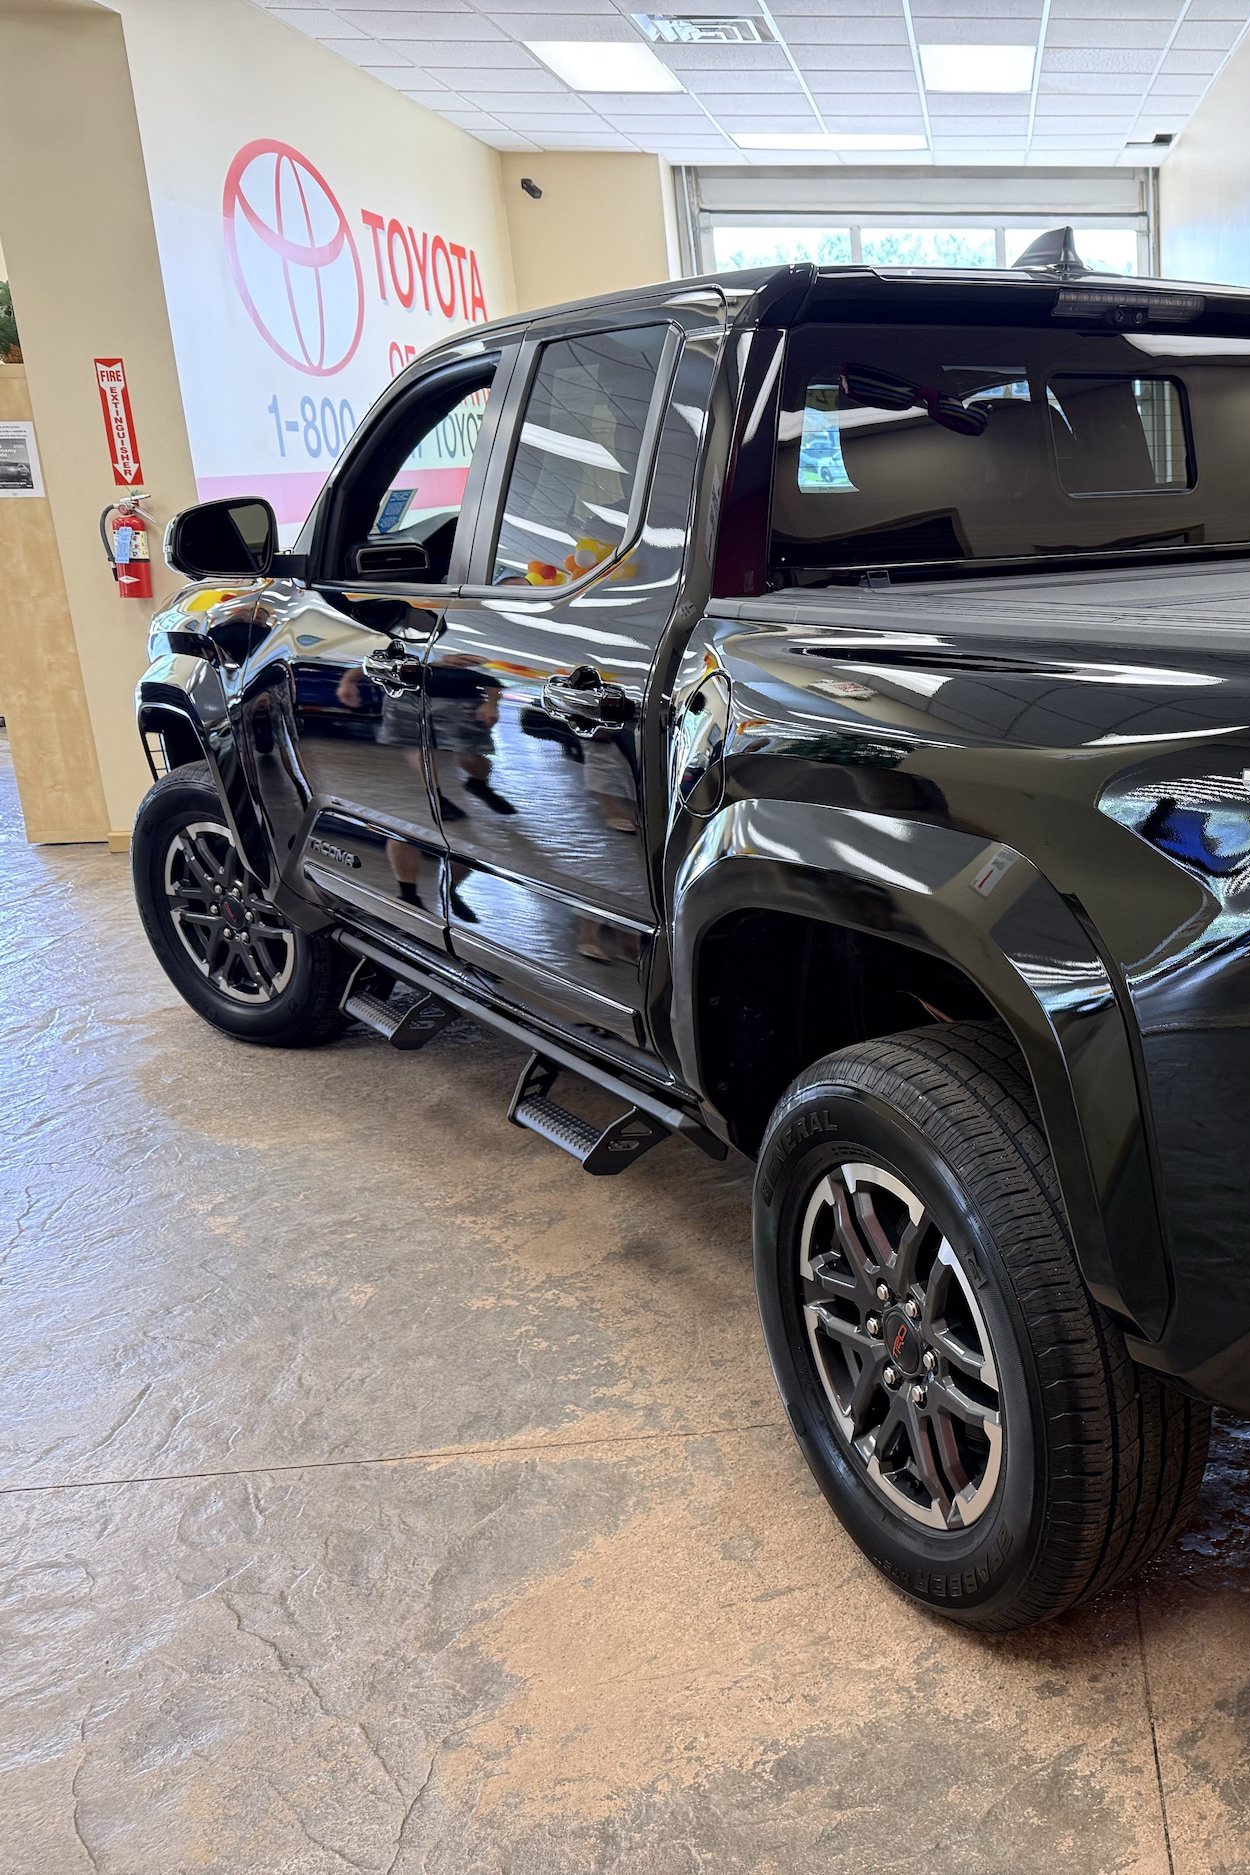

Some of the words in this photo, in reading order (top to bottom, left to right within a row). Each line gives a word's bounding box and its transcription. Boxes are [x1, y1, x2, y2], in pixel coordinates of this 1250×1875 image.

[360, 208, 489, 323] TOYOTA
[100, 370, 122, 382] FIRE
[109, 386, 132, 476] EXTINGUISHER
[267, 394, 356, 458] 1-800
[892, 1324, 908, 1359] TRD
